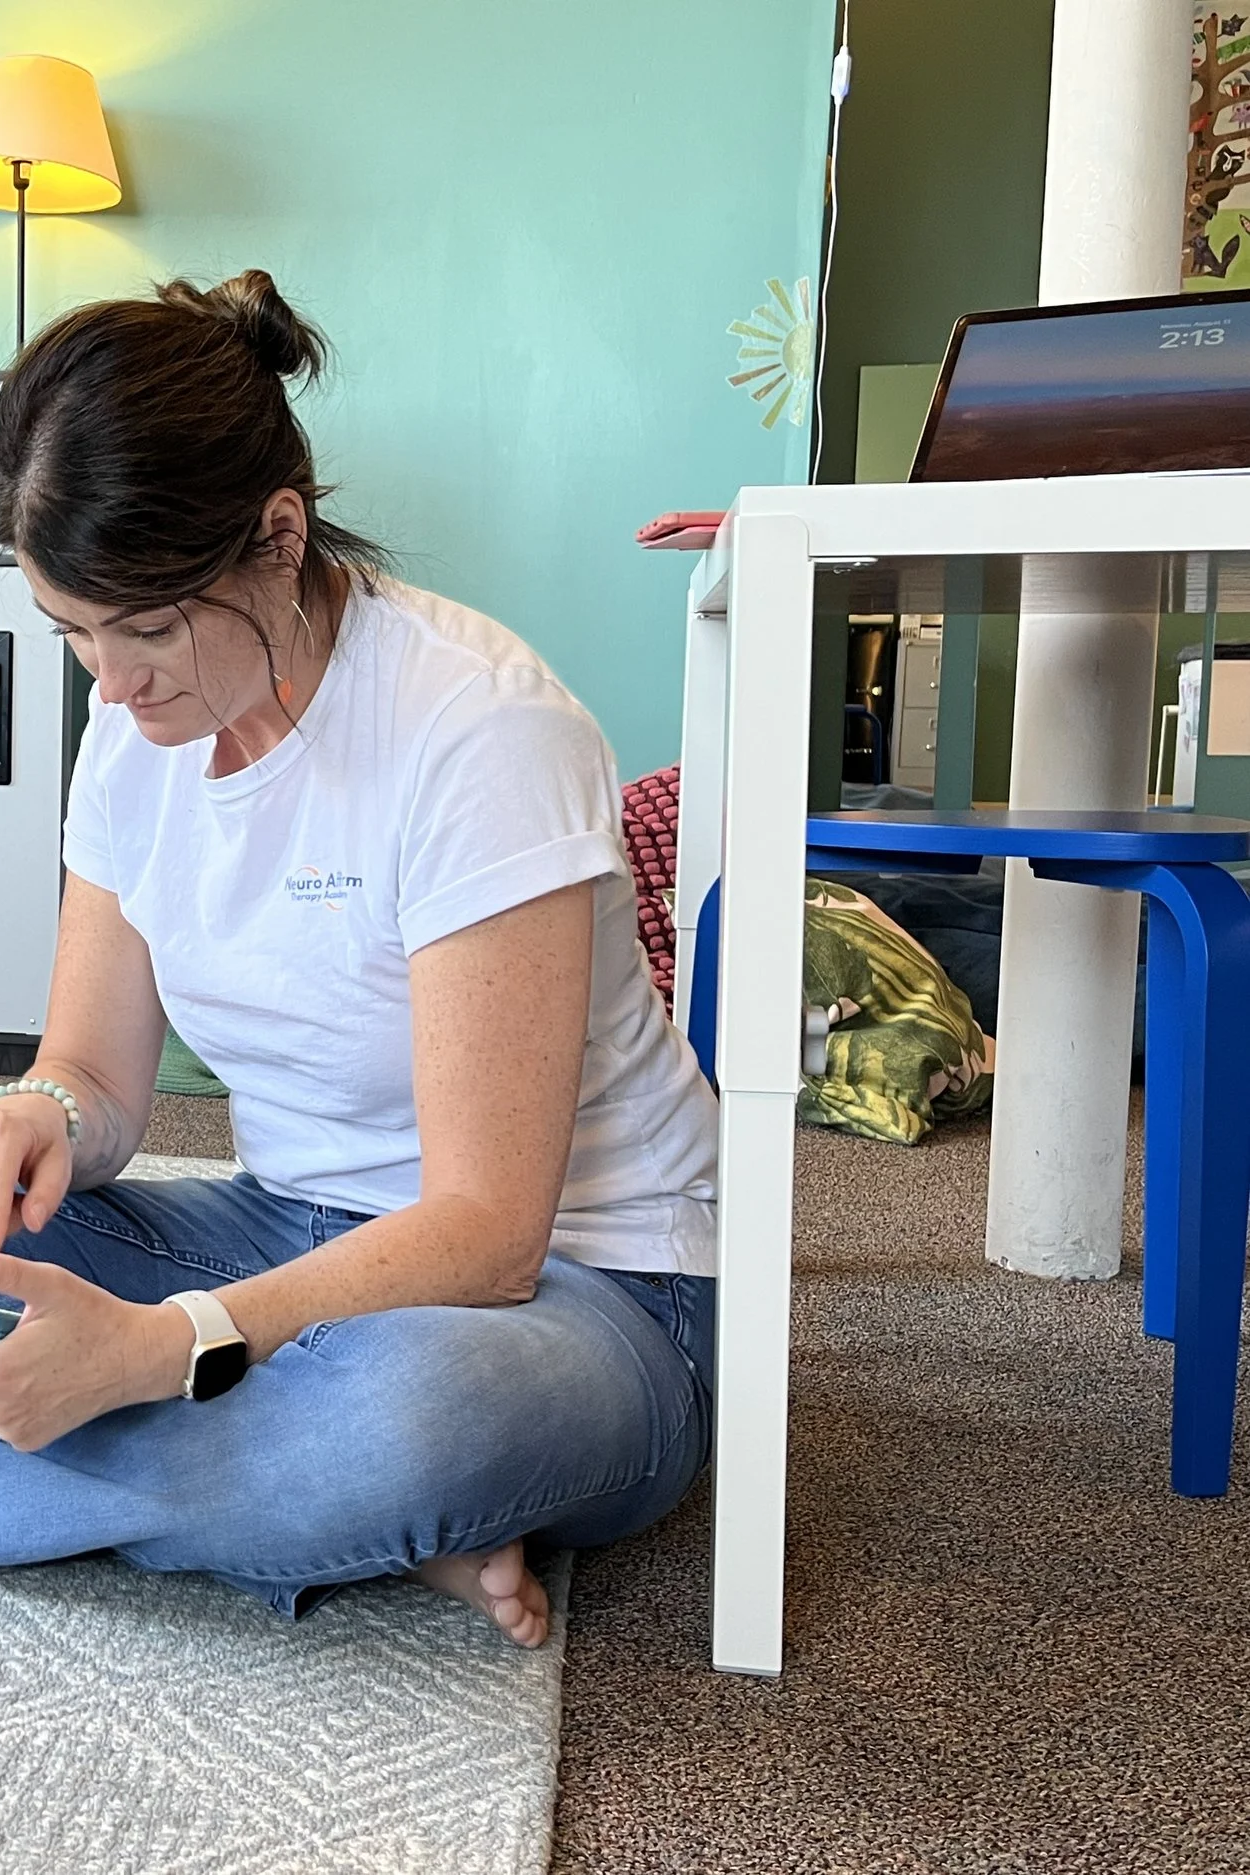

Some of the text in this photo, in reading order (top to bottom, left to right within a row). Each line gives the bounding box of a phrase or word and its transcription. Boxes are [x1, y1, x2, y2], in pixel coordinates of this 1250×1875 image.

[1159, 328, 1225, 349] 2:13
[284, 875, 322, 891] Neuro
[291, 892, 322, 902] Terapy
